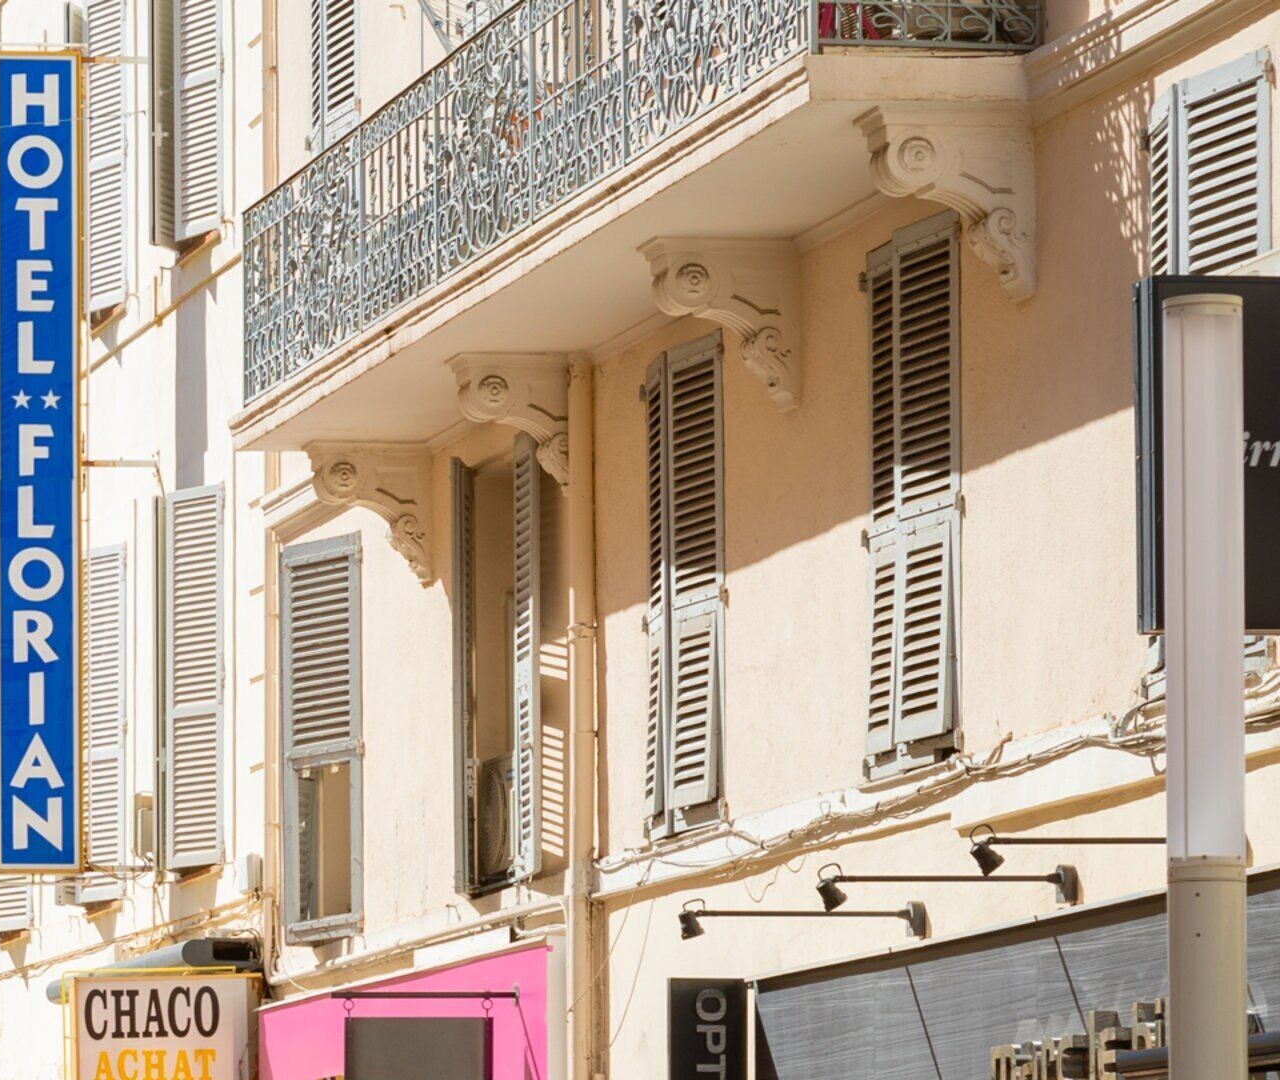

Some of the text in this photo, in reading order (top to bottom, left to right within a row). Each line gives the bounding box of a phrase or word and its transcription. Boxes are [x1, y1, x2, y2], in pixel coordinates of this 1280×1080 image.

[7, 73, 65, 852] HOTEL FLORIAN
[84, 985, 220, 1041] CHACO
